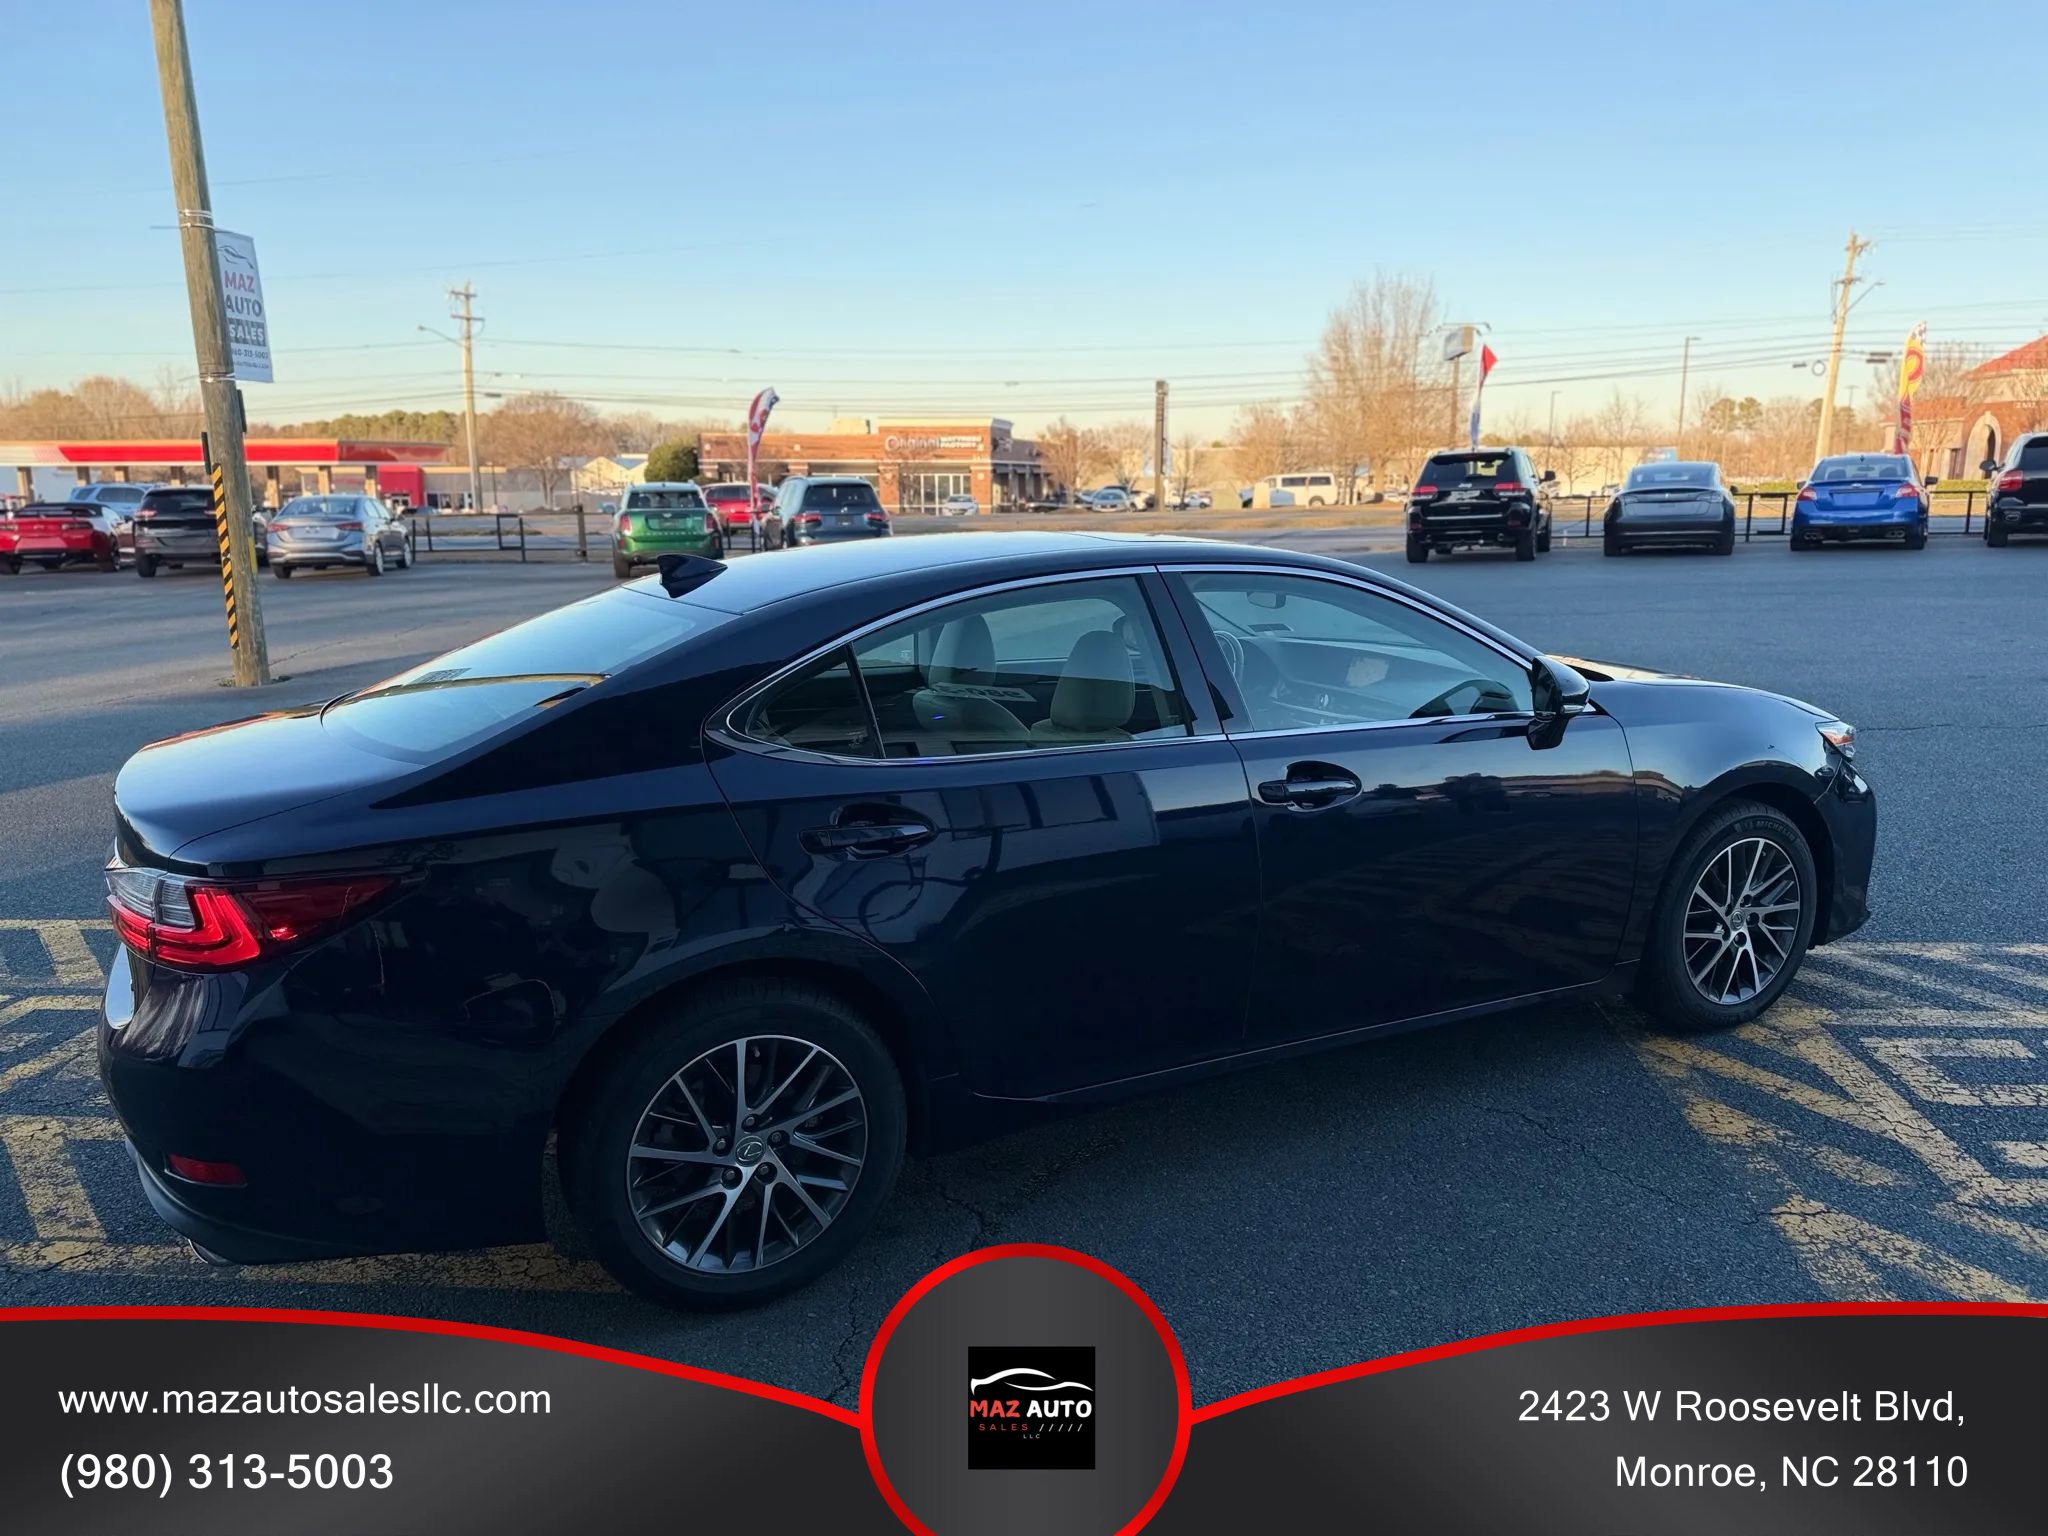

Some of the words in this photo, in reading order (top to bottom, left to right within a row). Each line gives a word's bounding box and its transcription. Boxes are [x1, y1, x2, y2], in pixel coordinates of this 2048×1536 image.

[224, 270, 255, 294] MAZ
[225, 294, 263, 317] AUTO
[229, 323, 264, 341] SALES
